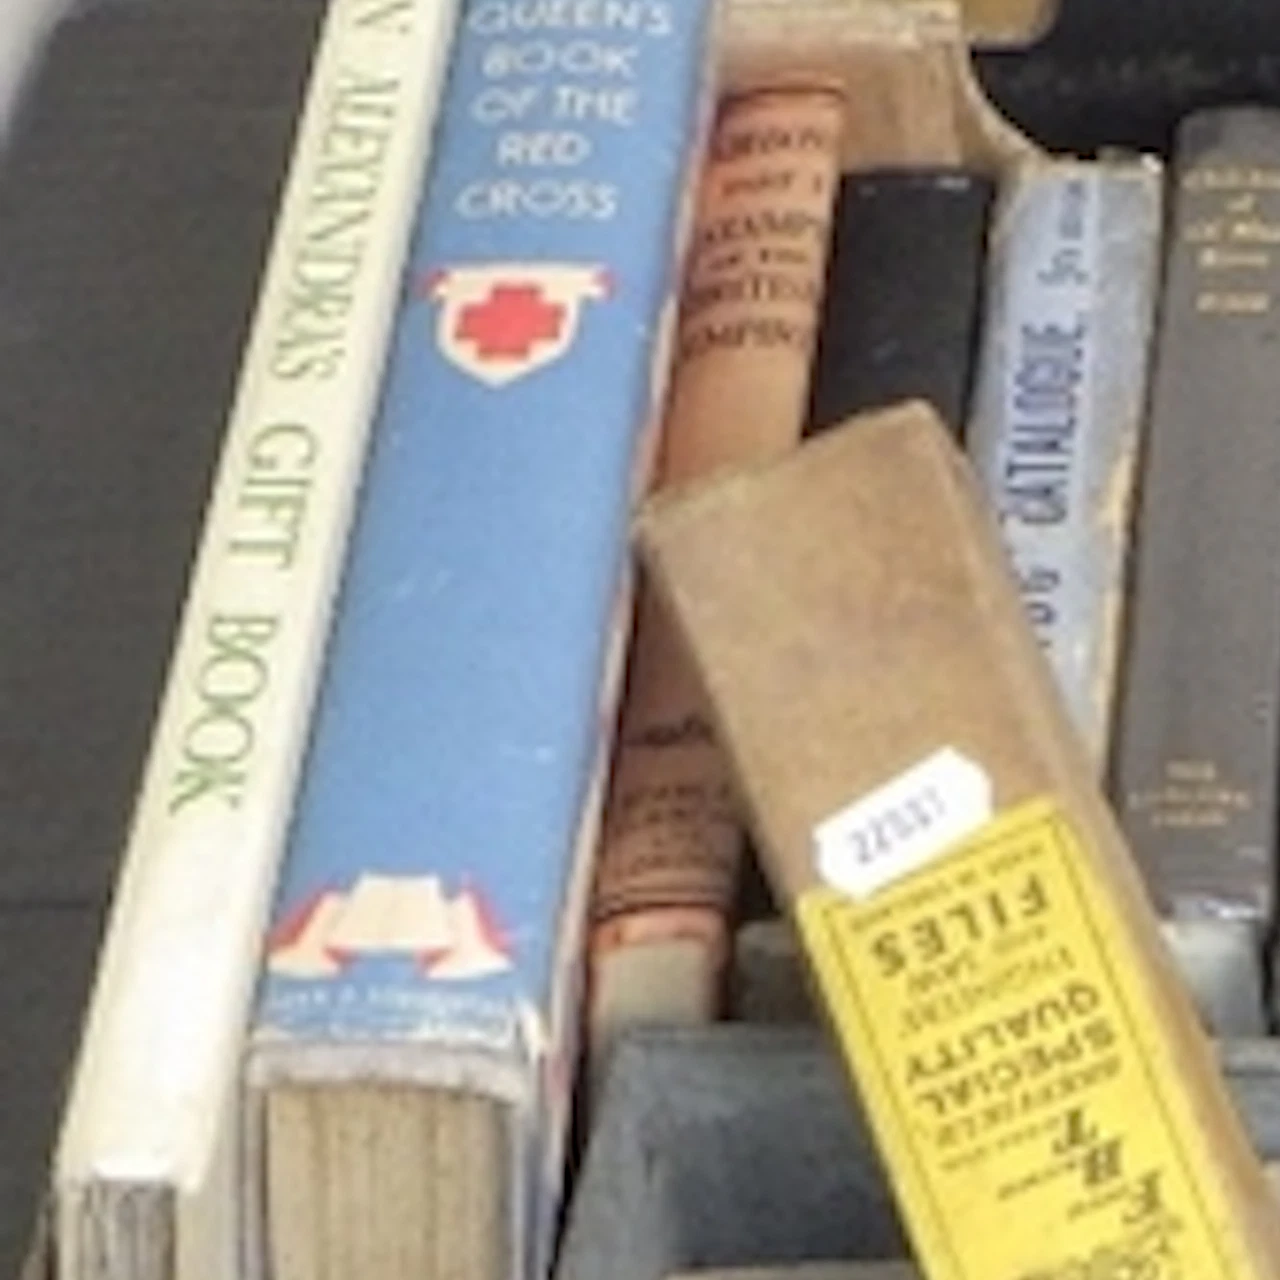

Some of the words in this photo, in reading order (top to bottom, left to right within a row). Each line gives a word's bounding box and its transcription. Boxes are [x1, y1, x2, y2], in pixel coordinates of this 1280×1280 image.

[472, 88, 540, 122] OF
[553, 86, 638, 122] THE
[483, 45, 639, 78] BOOK
[453, 182, 617, 218] CROSS
[497, 135, 590, 166] RED
[228, 423, 319, 573] GIFT
[169, 614, 276, 815] BOOK
[866, 869, 1052, 978] FILES
[895, 977, 1104, 1090] QUALITY
[914, 1016, 1118, 1124] SPECIAL
